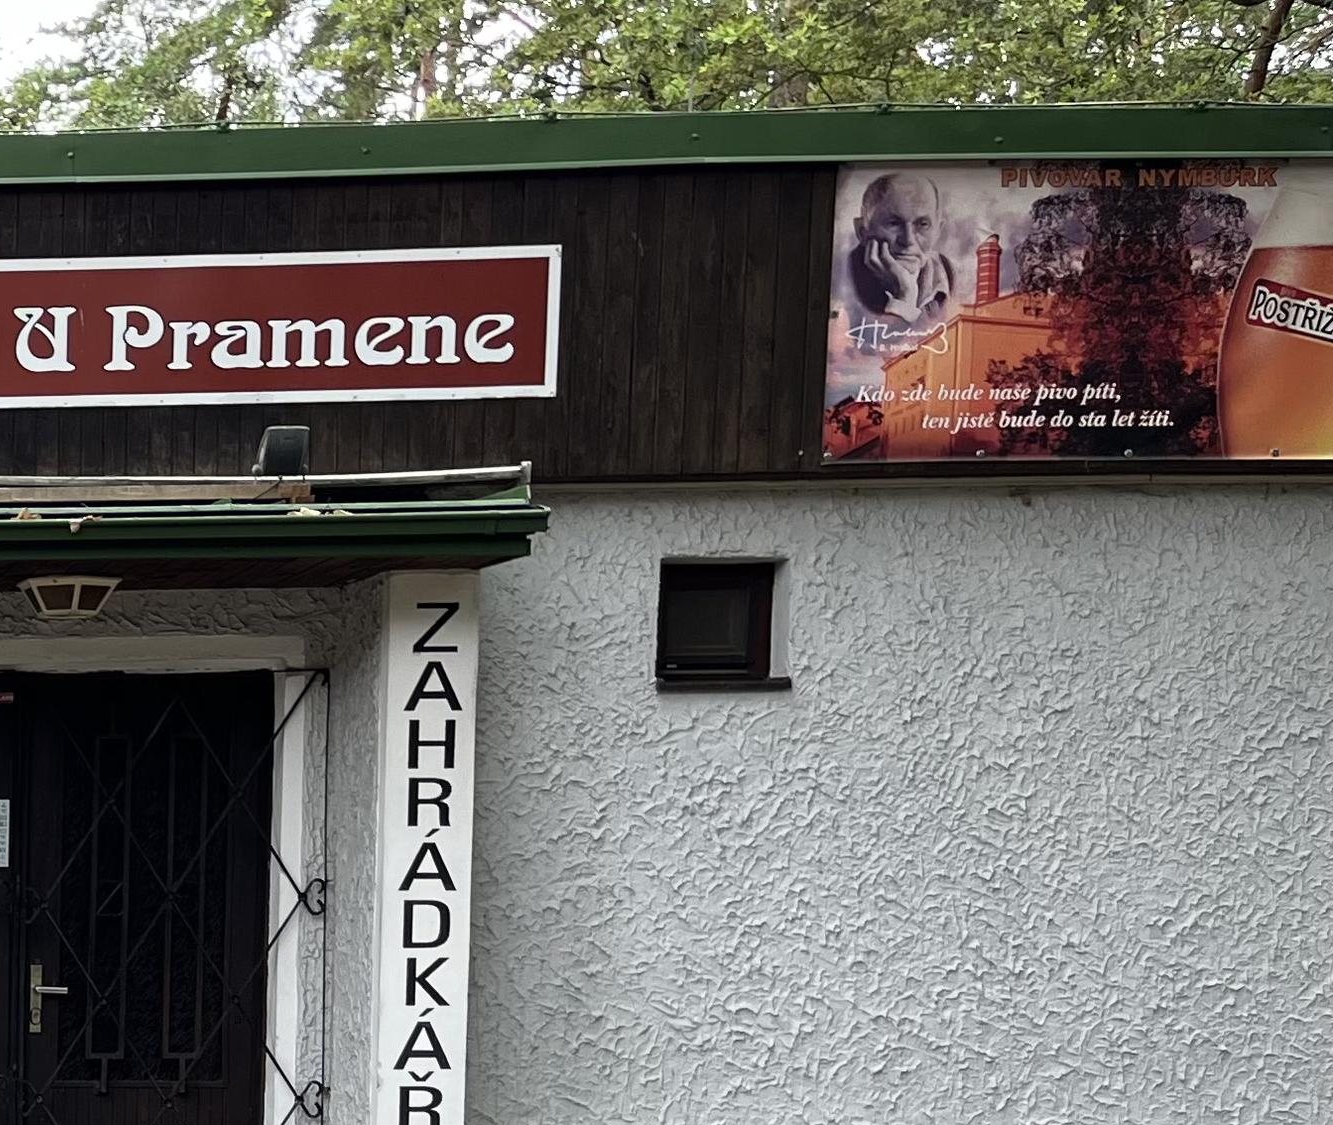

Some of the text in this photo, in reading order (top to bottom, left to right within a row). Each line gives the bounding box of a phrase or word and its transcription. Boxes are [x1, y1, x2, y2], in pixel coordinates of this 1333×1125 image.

[1001, 165, 1278, 188] PIVOVAR NYMBURK
[14, 306, 77, 373] U
[103, 303, 516, 372] Pramene
[855, 382, 1122, 406] Kdo zde bude naše pivo píti,
[922, 408, 1175, 436] ten jistě bude do sta let žíti.
